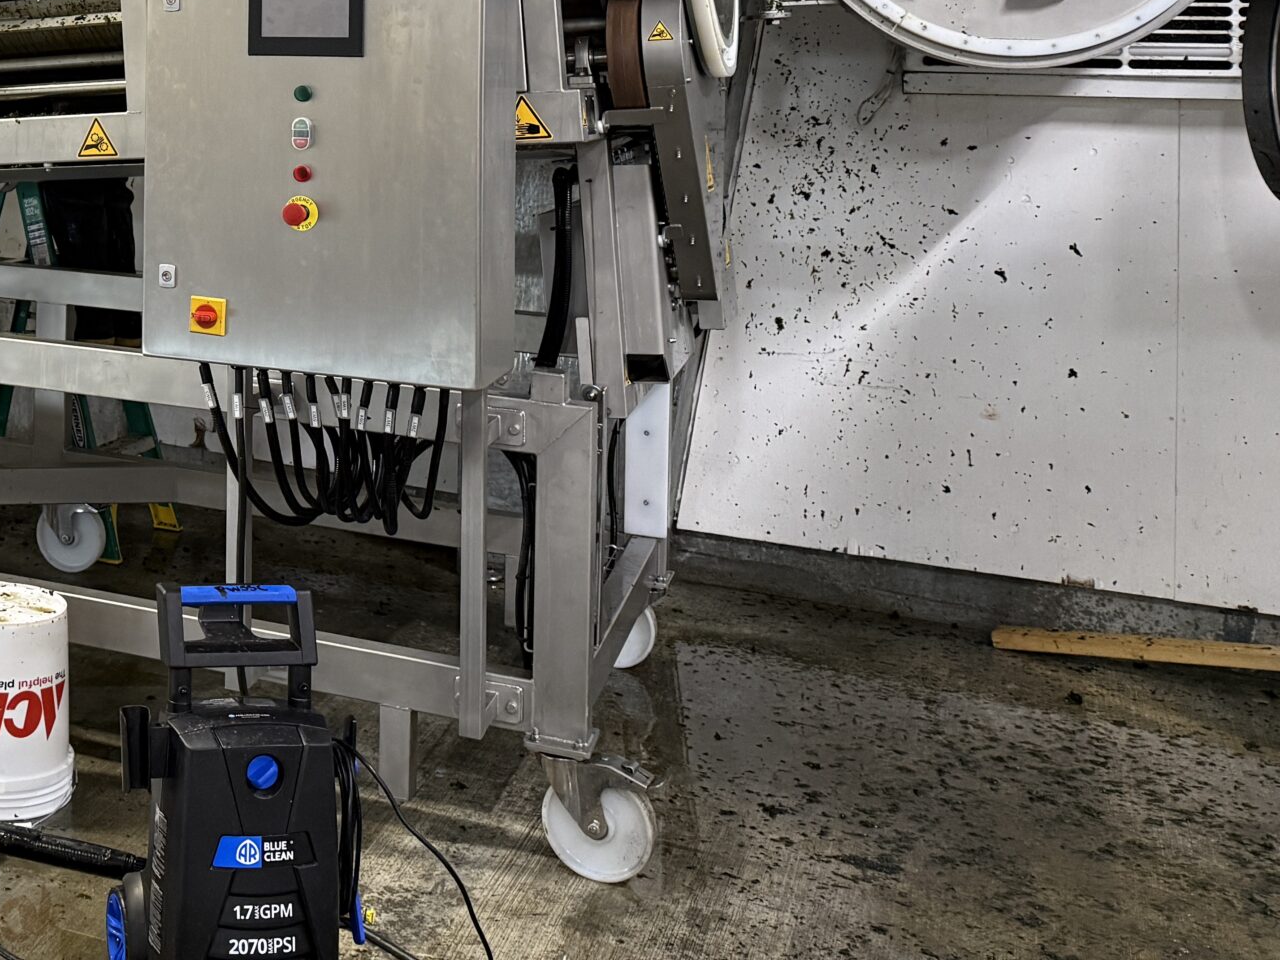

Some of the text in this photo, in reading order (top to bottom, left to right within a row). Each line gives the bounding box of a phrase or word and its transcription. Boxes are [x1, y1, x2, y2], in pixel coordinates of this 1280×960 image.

[55, 669, 66, 681] The
[18, 675, 54, 690] helpful
[263, 841, 287, 852] BLUE
[263, 851, 294, 862] CLEAN
[233, 905, 254, 920] 1.7
[260, 902, 293, 919] GPM
[228, 938, 268, 955] 2070
[273, 936, 296, 954] PSI
